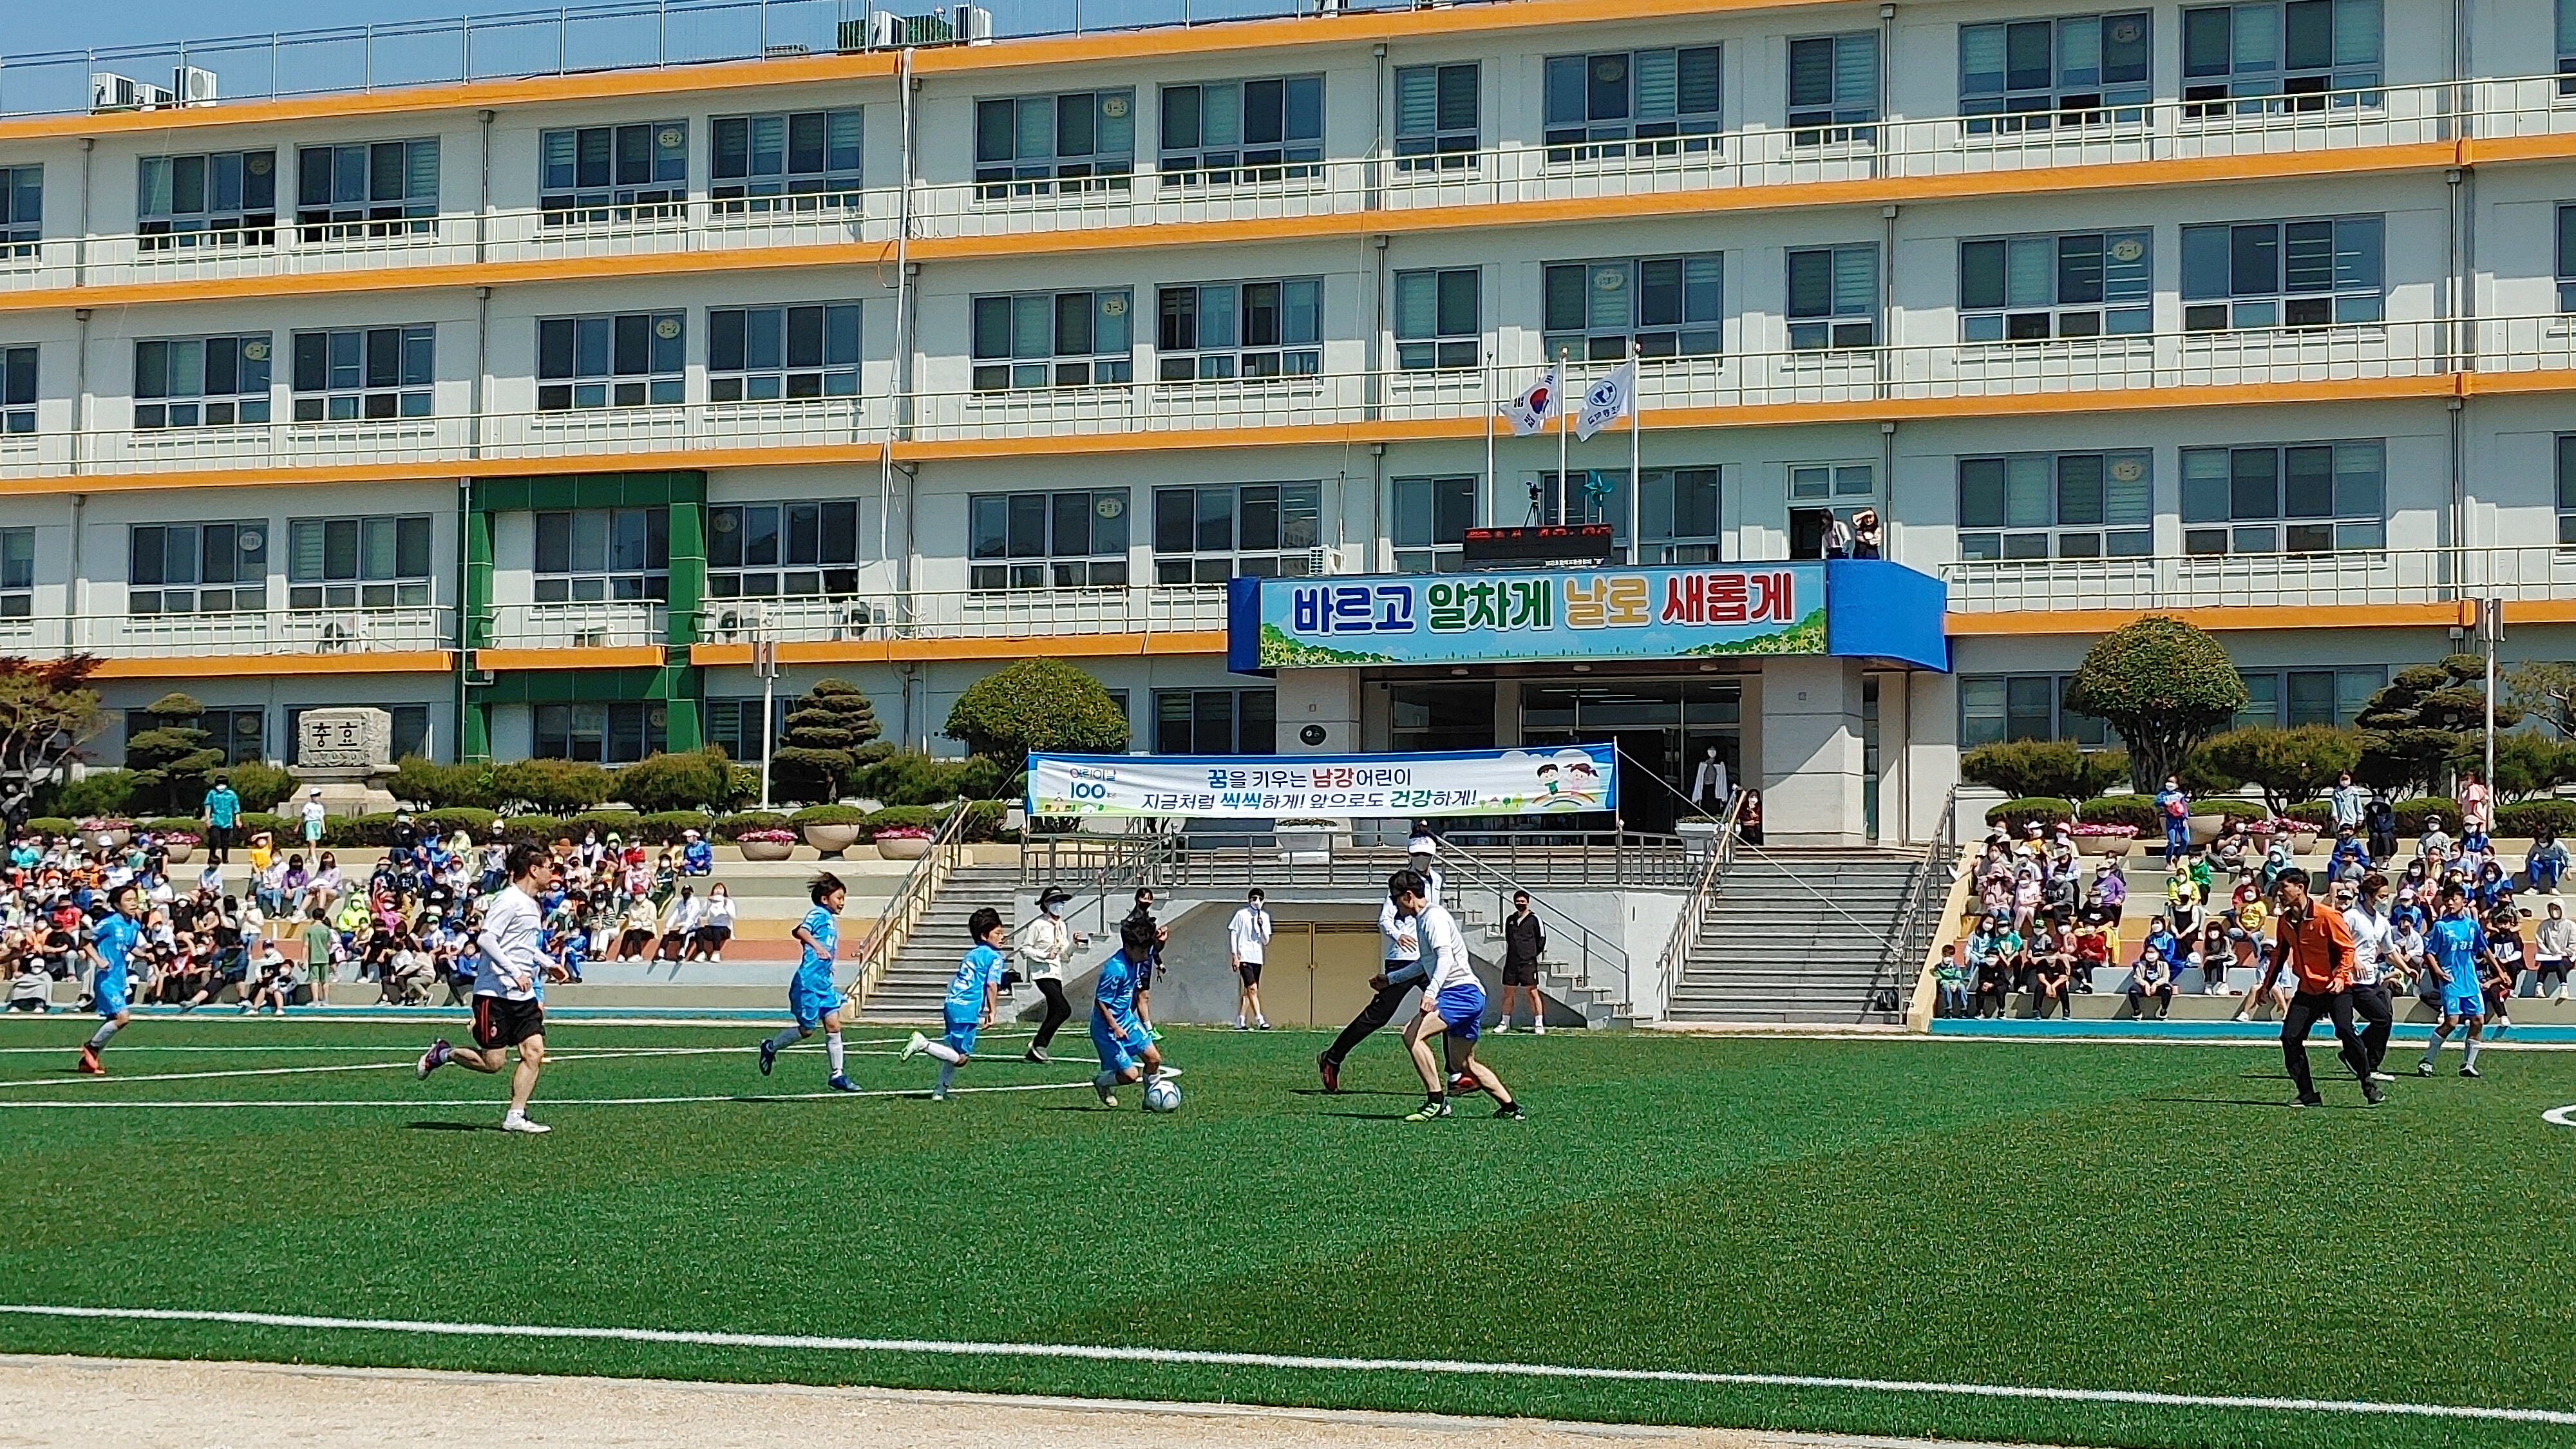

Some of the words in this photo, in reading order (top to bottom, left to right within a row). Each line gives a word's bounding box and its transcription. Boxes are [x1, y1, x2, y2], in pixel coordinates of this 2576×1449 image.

[662, 134, 679, 144] 5-2
[2118, 245, 2138, 256] 2-1
[1293, 584, 1416, 634] 바르고
[1427, 579, 1552, 630] 알차게
[1565, 578, 1649, 626] 날로
[1661, 573, 1794, 623] 새롭게
[312, 722, 358, 748] 충효
[1208, 769, 1247, 789] 꿈을
[1251, 770, 1307, 789] 키우는
[1141, 793, 1215, 810] 지금처럼
[1220, 792, 1306, 810] 씩씩하게!
[1309, 793, 1385, 809] 앞으로도
[1389, 789, 1477, 808] 건강하게!
